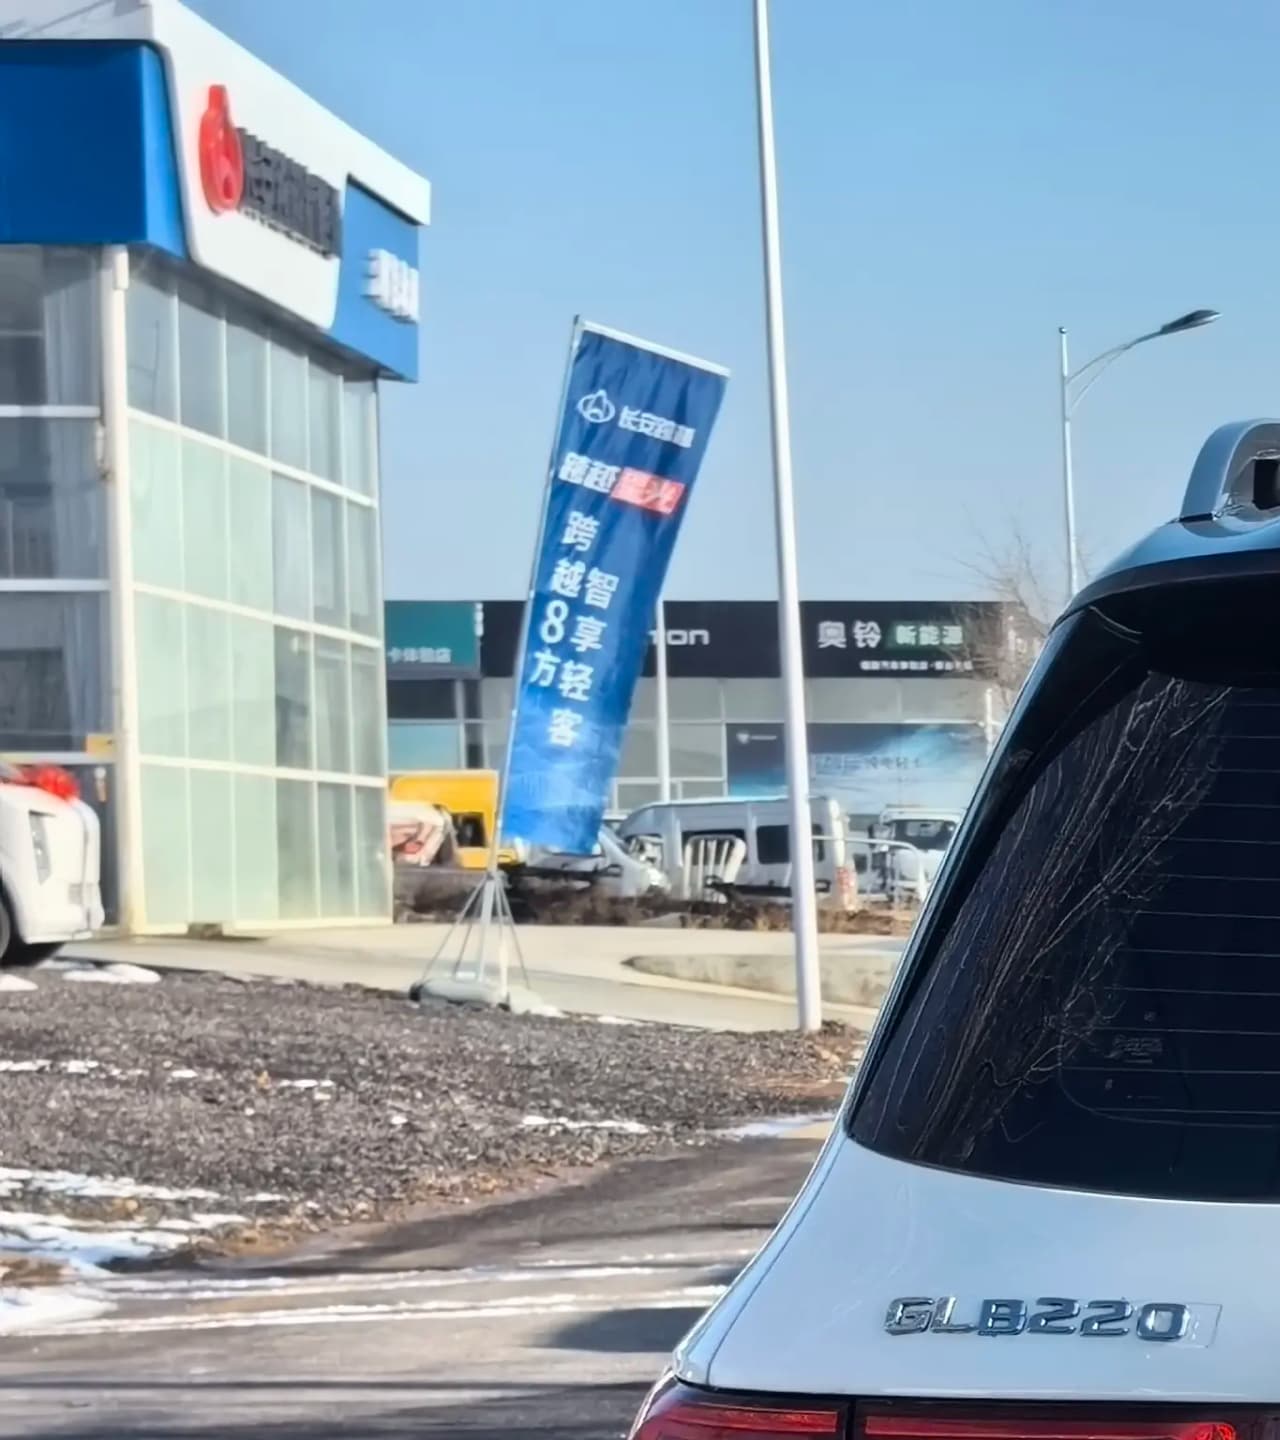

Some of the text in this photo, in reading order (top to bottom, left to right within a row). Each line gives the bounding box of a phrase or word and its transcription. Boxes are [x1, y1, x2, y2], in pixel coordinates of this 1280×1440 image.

[817, 620, 964, 648] 奥铃 新能源
[548, 567, 620, 747] 智享轻客
[884, 1297, 1188, 1342] GLB220
